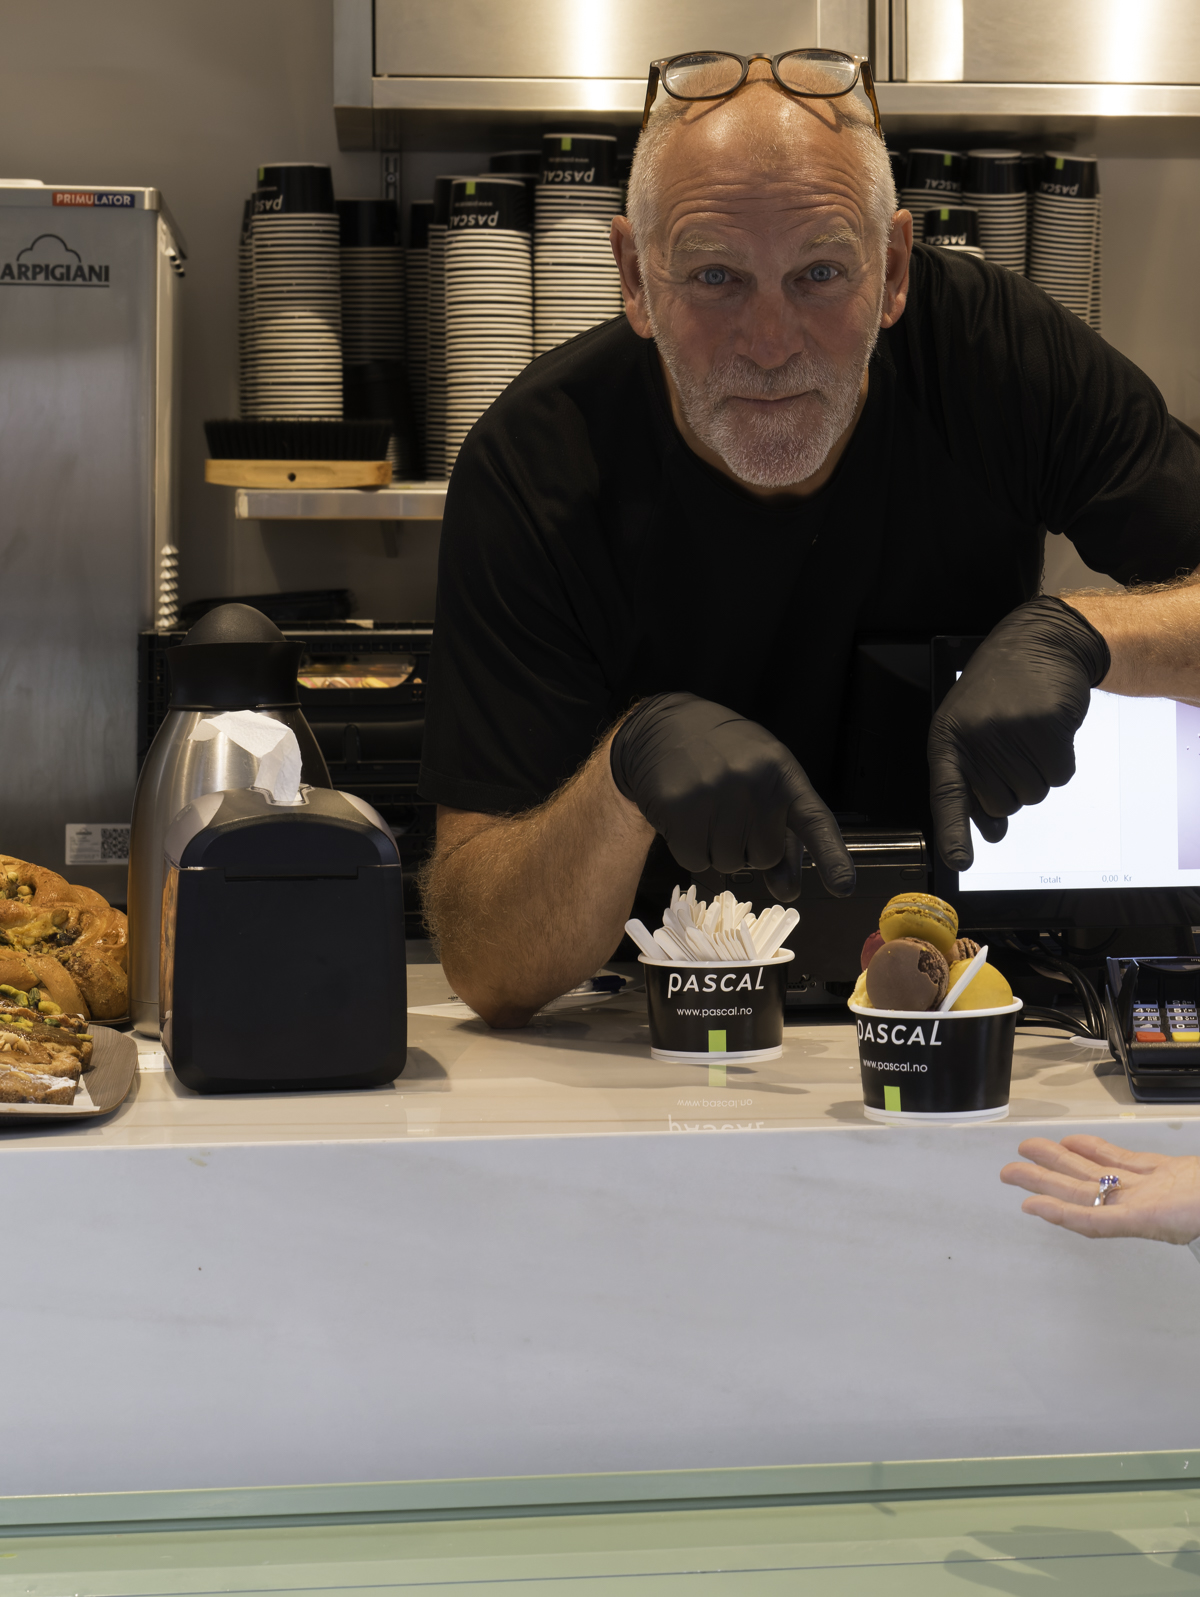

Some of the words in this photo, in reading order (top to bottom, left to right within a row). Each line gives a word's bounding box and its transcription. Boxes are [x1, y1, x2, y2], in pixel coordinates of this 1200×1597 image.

[56, 193, 131, 206] PRIMULATOR
[1039, 876, 1062, 884] Totalt
[1101, 874, 1119, 883] 0,00
[1123, 874, 1133, 882] Kr
[676, 1006, 753, 1018] www.pascal.no
[863, 1058, 928, 1073] www.pascal.no
